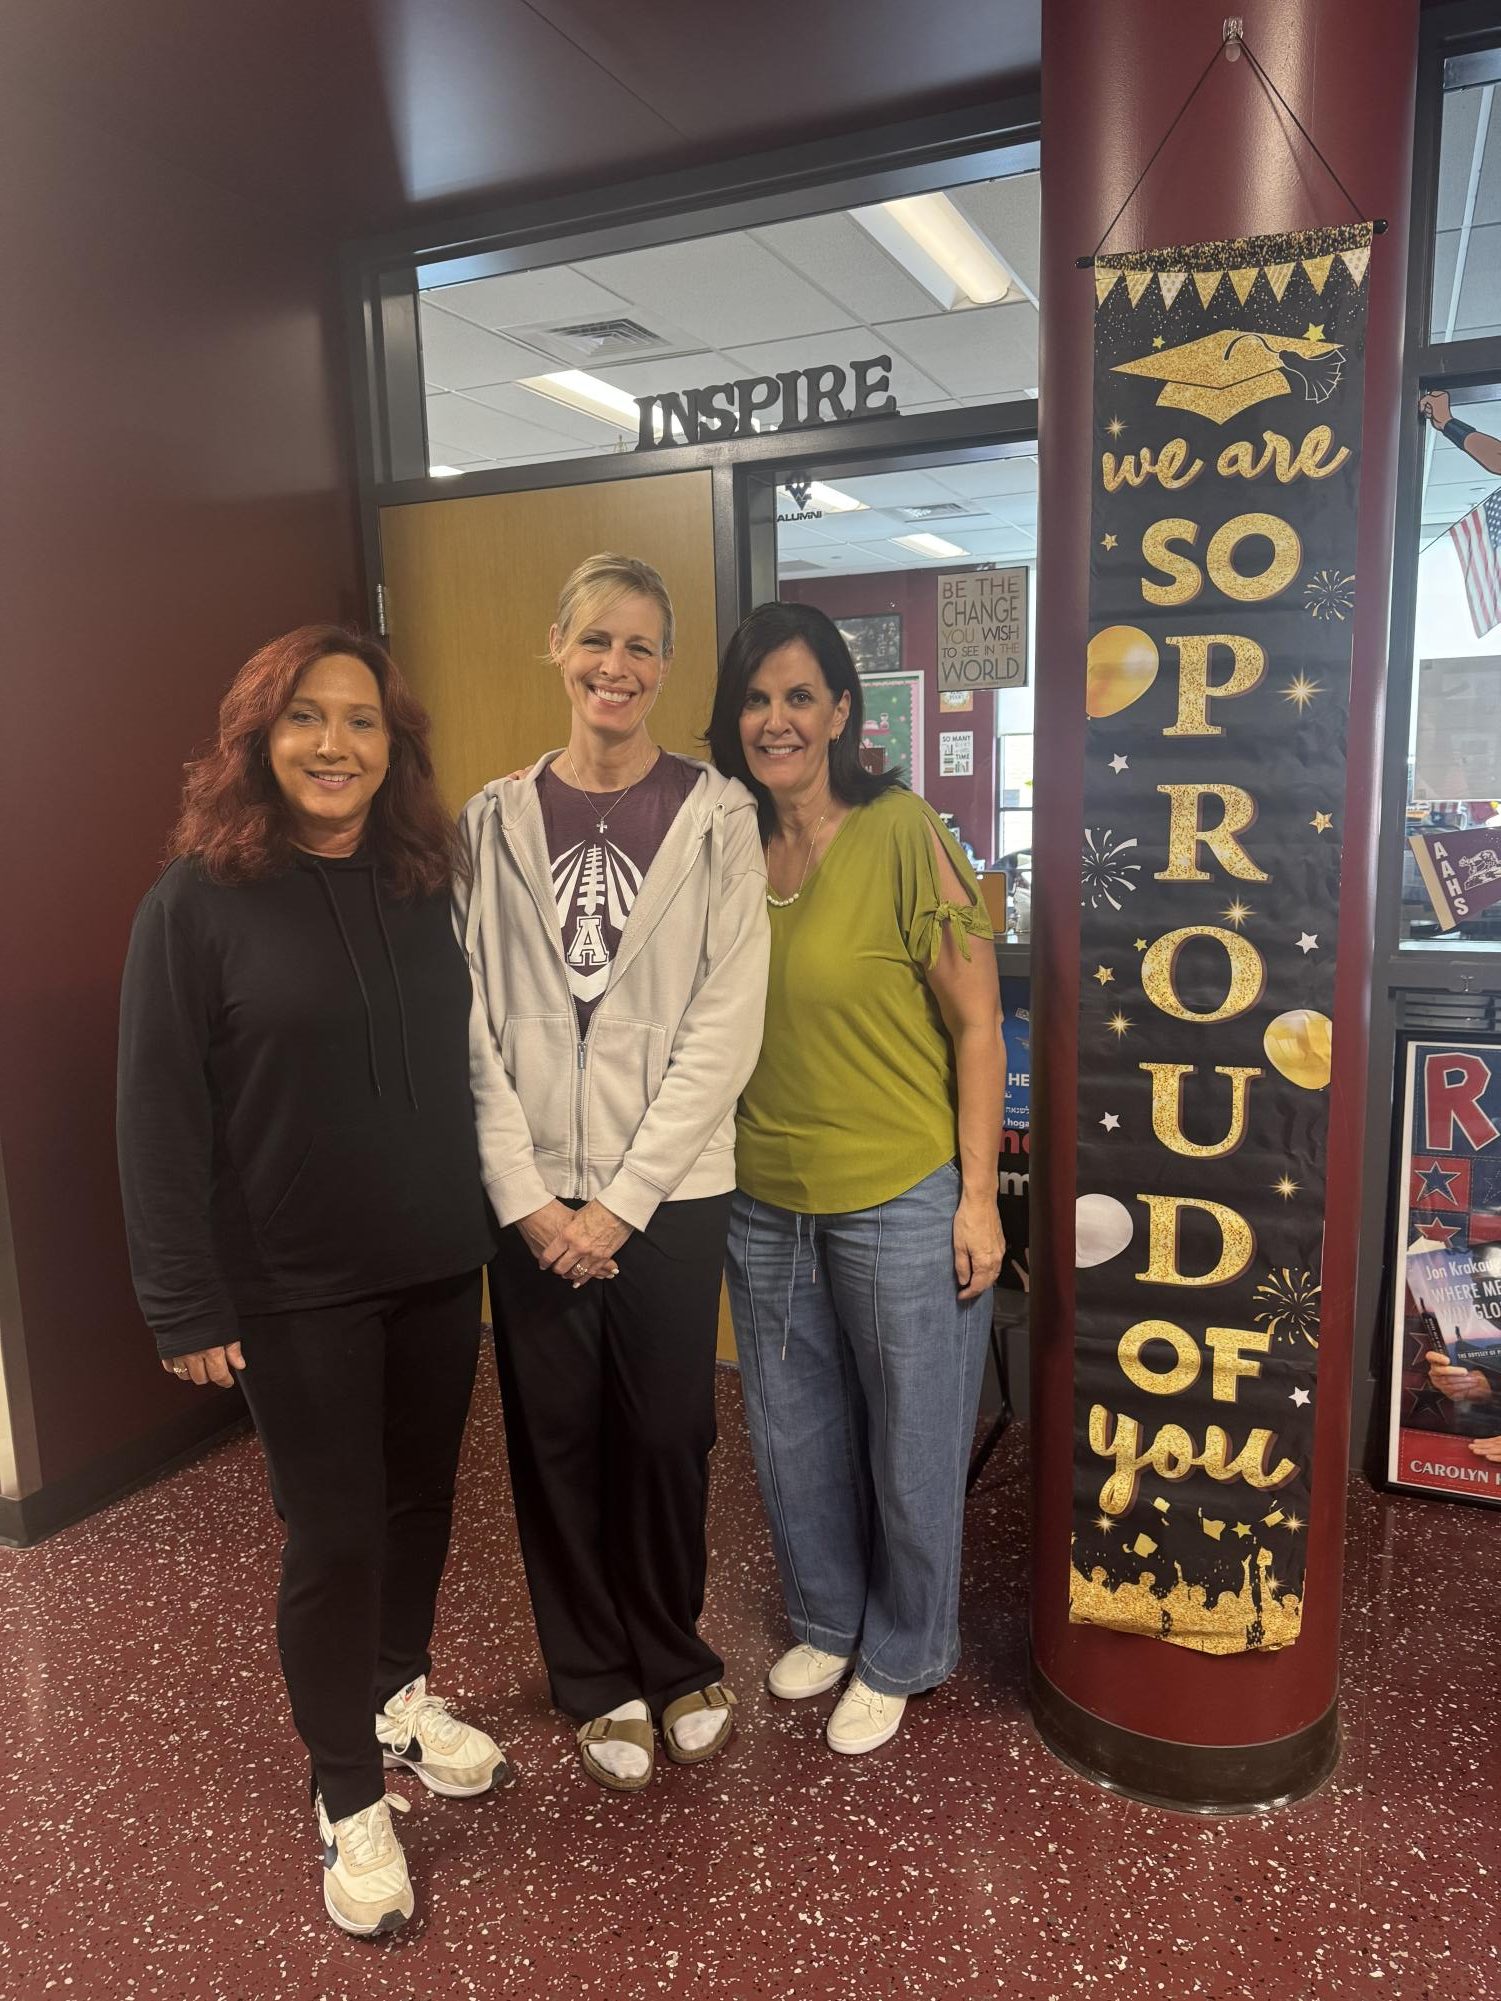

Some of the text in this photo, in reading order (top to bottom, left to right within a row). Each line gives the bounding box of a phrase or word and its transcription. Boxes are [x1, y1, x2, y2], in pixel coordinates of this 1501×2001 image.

[633, 354, 897, 452] INSPIRE
[1102, 424, 1352, 493] we are
[776, 510, 822, 522] ALUMNI
[1140, 512, 1304, 607] SO
[942, 575, 1020, 600] BE THE
[942, 595, 1020, 628] CHANGE
[942, 623, 1020, 645] YOU WISH
[942, 642, 1019, 659] TO SEE IN THE
[942, 657, 1020, 683] WORLD
[1433, 841, 1469, 916] AAHS
[567, 915, 610, 967] A
[1008, 1072, 1030, 1087] HE
[1007, 1117, 1030, 1129] hoga
[1425, 1257, 1496, 1281] Jon Krakau
[1431, 1279, 1501, 1304] WHERE ME
[1473, 1301, 1501, 1320] GLO
[1116, 1318, 1274, 1403] OF
[1088, 1403, 1299, 1516] you
[1410, 1459, 1489, 1484] CAROLYN
